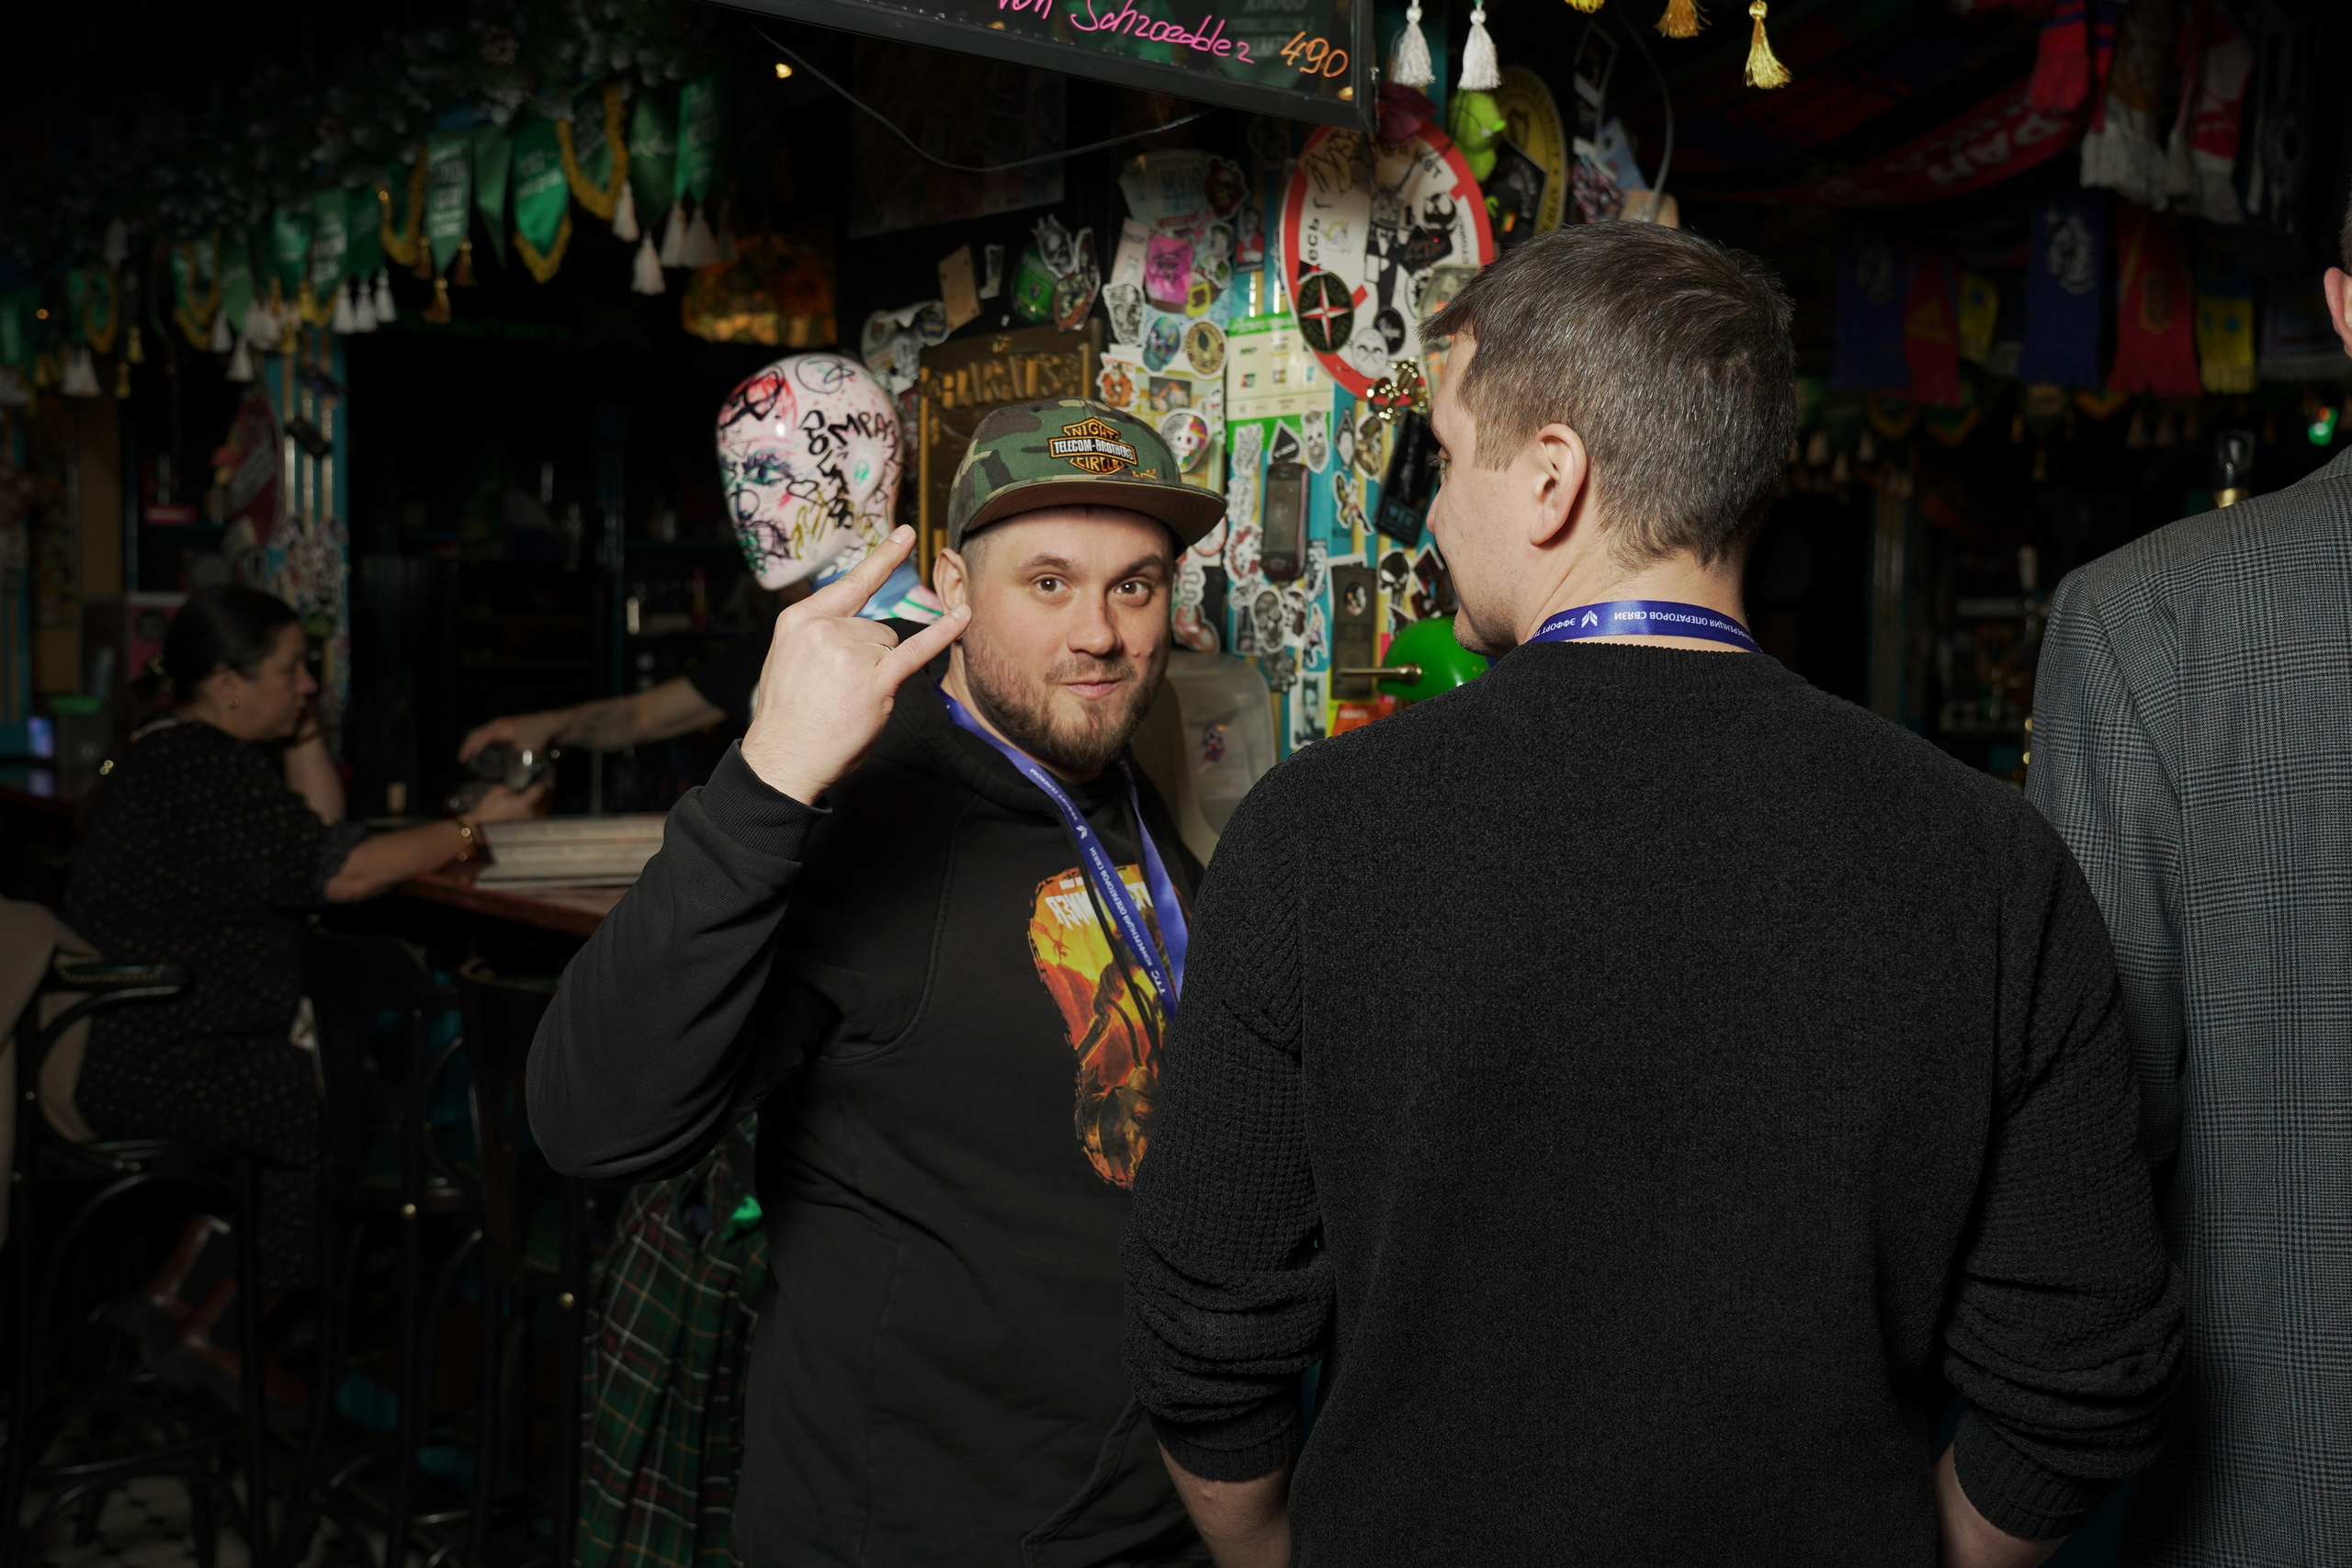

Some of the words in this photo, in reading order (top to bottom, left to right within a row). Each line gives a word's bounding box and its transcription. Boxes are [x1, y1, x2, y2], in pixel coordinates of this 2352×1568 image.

[1279, 29, 1349, 78] 490
[1071, 422, 1114, 439] NIGHT
[1053, 438, 1135, 461] TELECOM-BROTHERS
[1076, 457, 1119, 472] CIRCLE
[1613, 611, 1647, 620] СВЯЗИ
[1649, 611, 1708, 626] ОПЕРАТОРОВ
[1542, 617, 1577, 635] ЭФФОРТ
[1089, 847, 1104, 871] СВЯЗИ
[1101, 869, 1127, 916] ОПЕРАТОРОВ
[1123, 913, 1153, 967] КОНФЕРЕНЦИЯ
